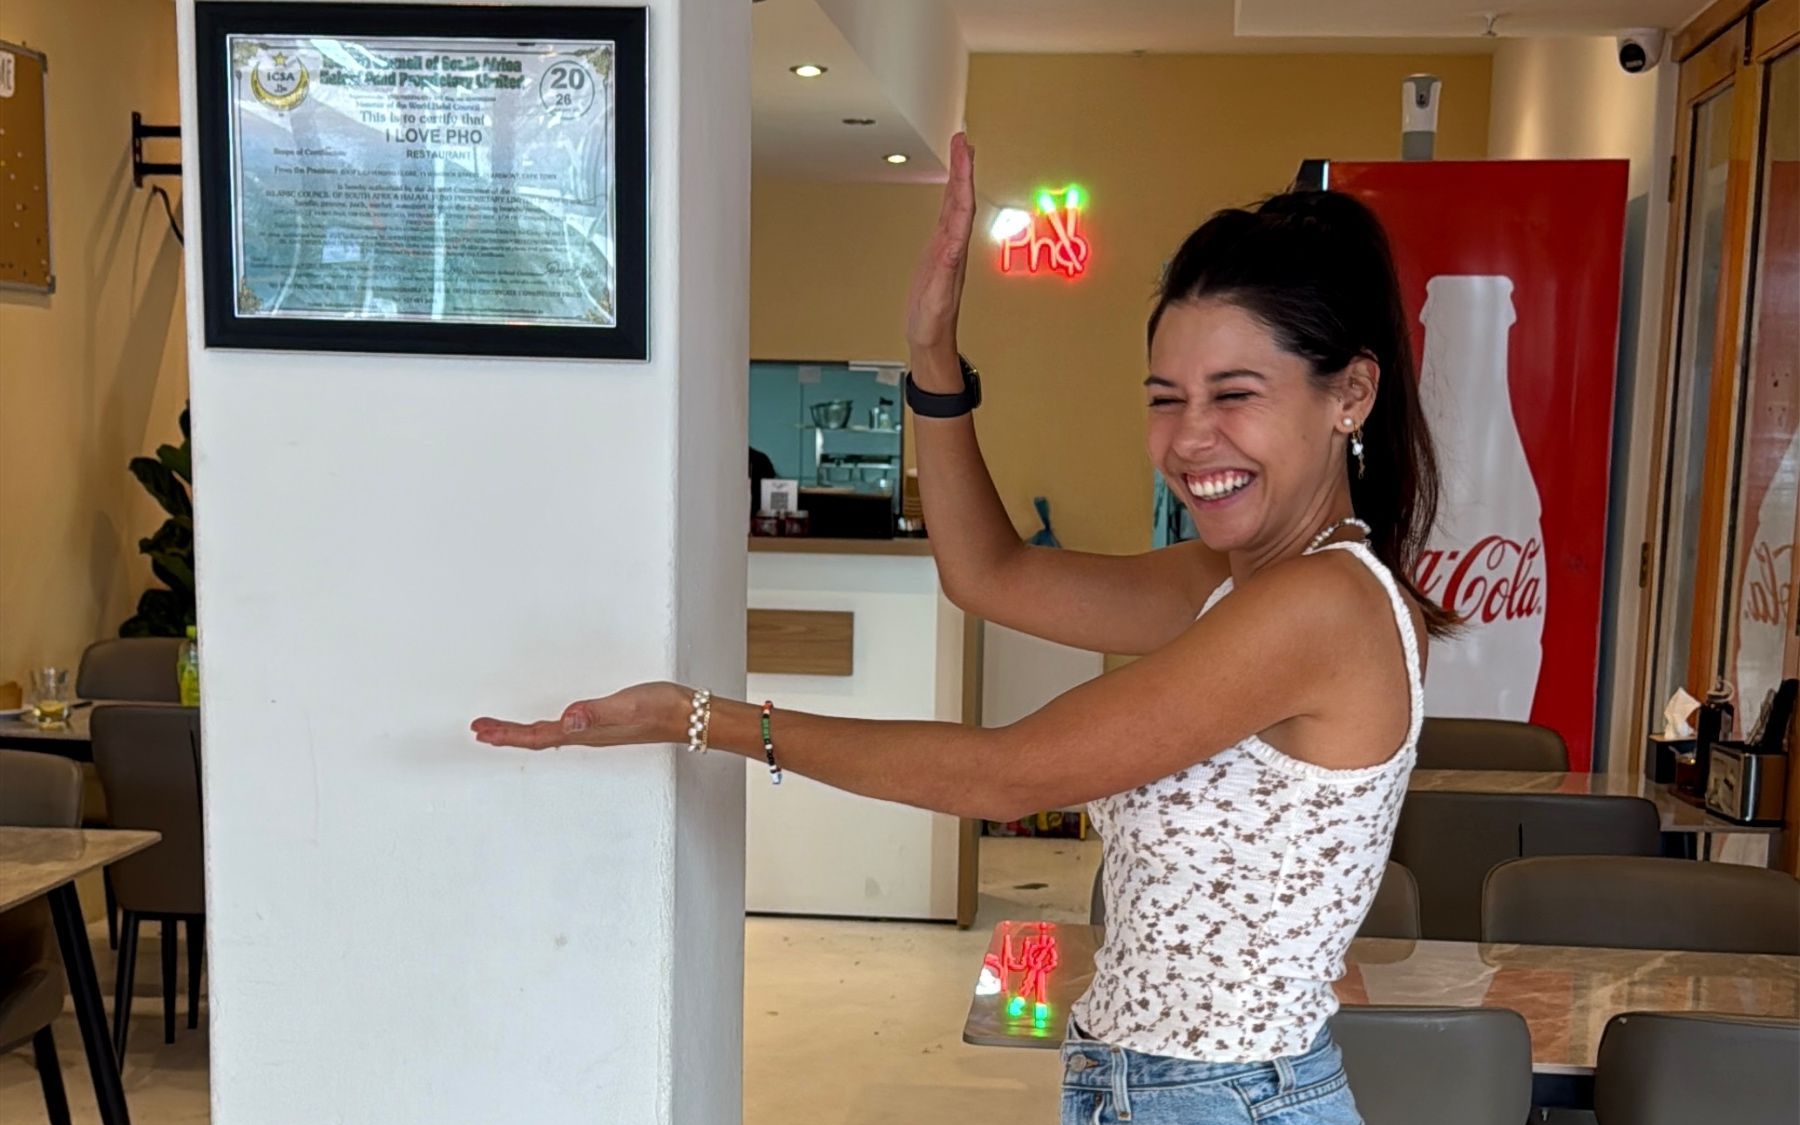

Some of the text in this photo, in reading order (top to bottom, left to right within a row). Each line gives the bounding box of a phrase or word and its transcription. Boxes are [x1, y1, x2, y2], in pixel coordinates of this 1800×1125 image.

[426, 55, 440, 71] of
[483, 57, 523, 73] Africa
[266, 71, 296, 82] ICSA
[551, 67, 585, 90] 20
[555, 93, 572, 106] 26
[360, 111, 386, 123] This
[403, 113, 417, 124] to
[420, 113, 458, 126] certify
[462, 113, 485, 126] that
[386, 128, 483, 145] I LOVE PHO
[406, 149, 471, 160] RESTAURANT
